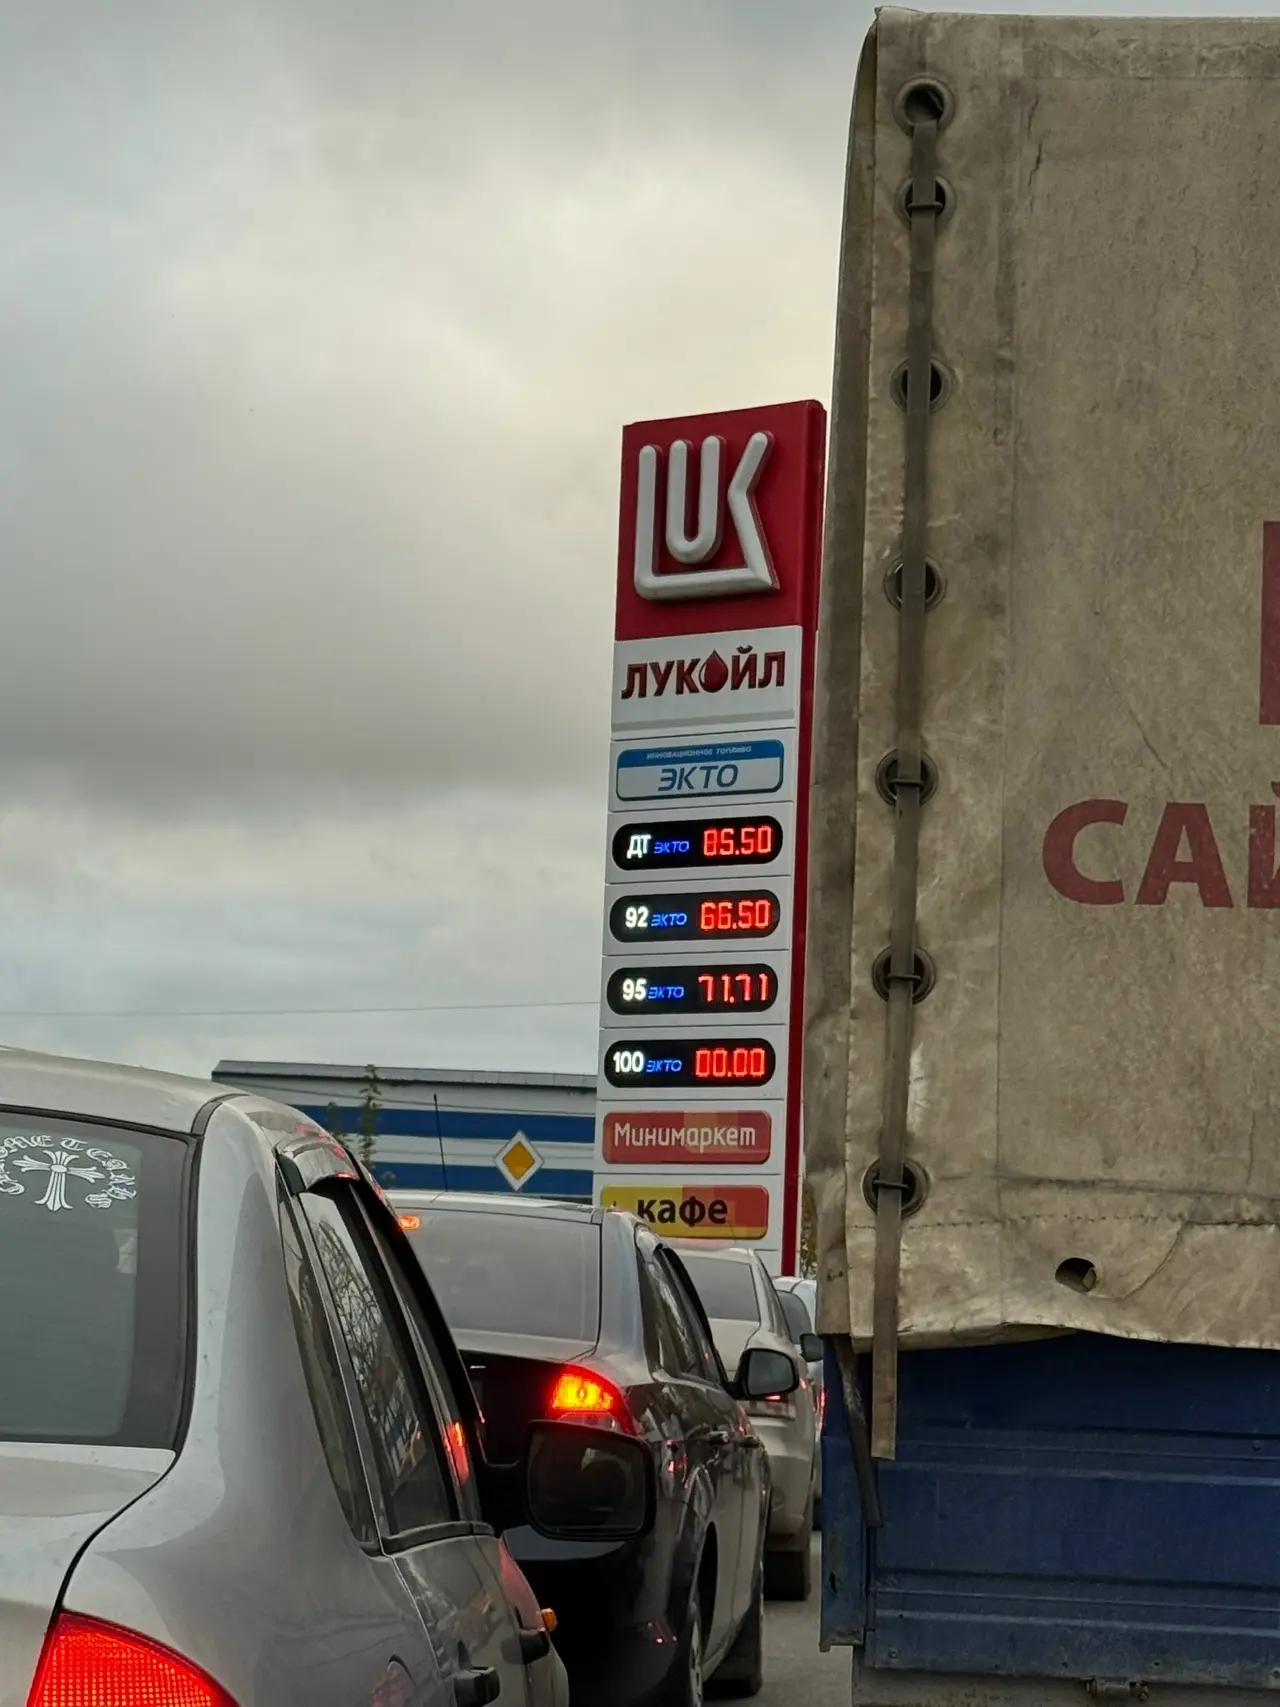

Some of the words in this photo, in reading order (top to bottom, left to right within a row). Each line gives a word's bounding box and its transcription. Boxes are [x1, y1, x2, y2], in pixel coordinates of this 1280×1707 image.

[621, 645, 786, 700] ЛУКОЙЛ
[657, 764, 738, 791] ЭКТО
[626, 834, 651, 859] ДТ
[653, 840, 690, 854] ЭКТО
[625, 906, 648, 928] 92
[651, 913, 687, 926] ЭКТО
[700, 899, 771, 930] 66.50
[622, 978, 647, 1000] 95
[648, 986, 684, 999] ЭКТО
[698, 973, 768, 1003] 71.71
[613, 1051, 644, 1073] 100
[646, 1059, 682, 1072] ЭКТО
[695, 1048, 765, 1077] 00.00
[614, 1122, 756, 1153] Минимаркет
[637, 1196, 728, 1227] кафе
